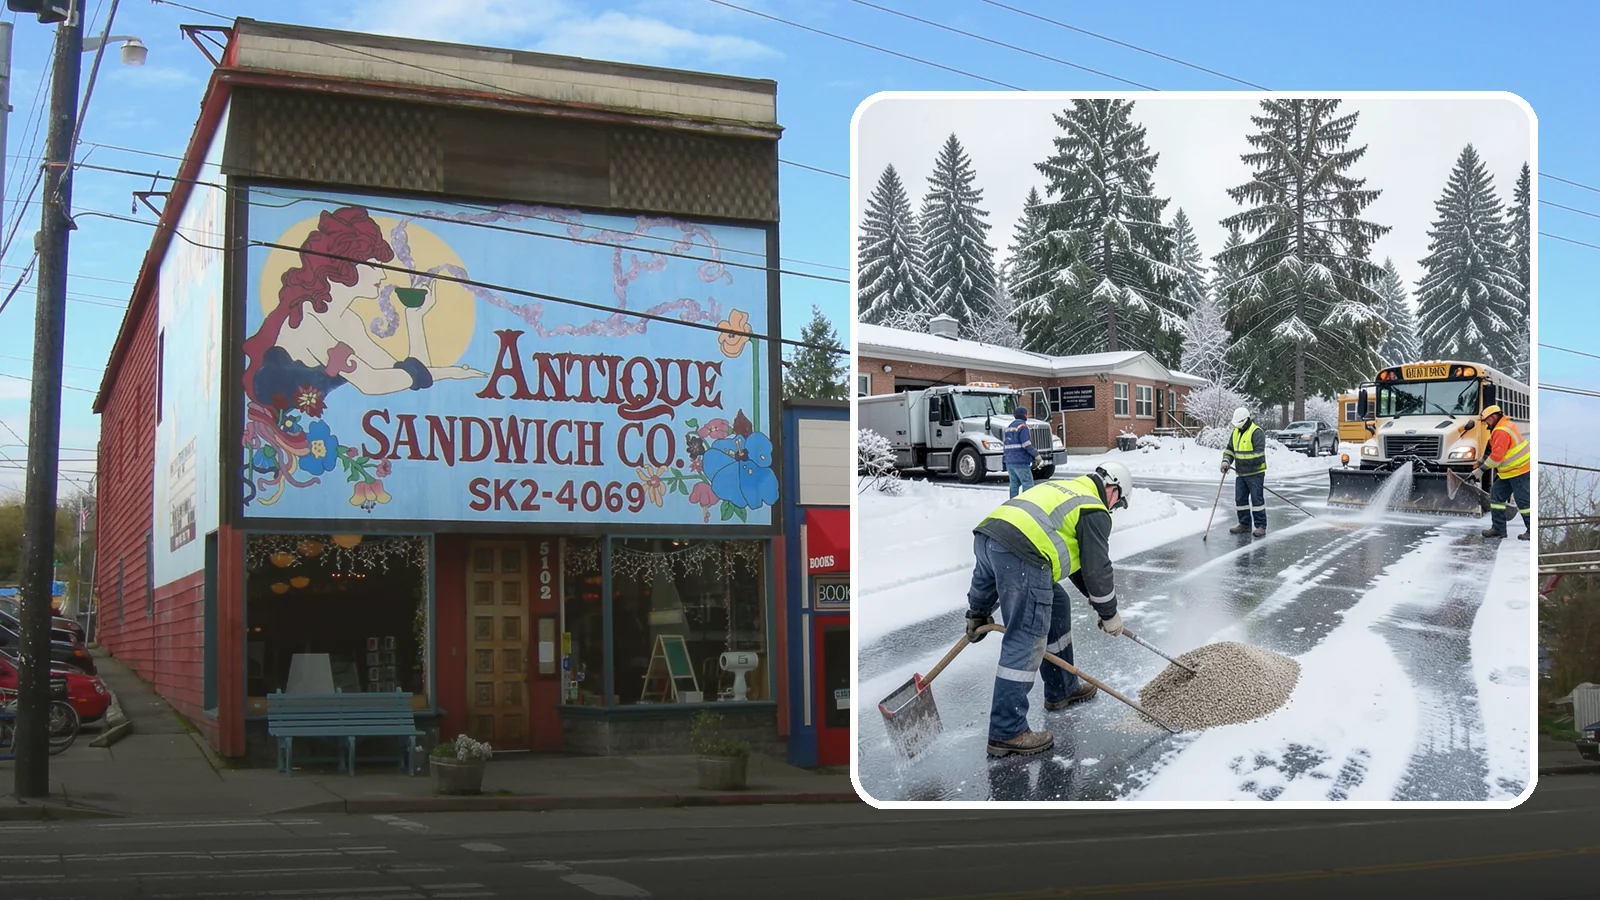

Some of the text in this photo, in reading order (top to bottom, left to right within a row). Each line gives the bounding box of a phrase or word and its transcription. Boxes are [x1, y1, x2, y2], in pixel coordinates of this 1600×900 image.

[476, 328, 724, 421] ANTIQUE
[361, 408, 685, 469] SANDWICH CO.
[468, 477, 646, 513] SK2-4069
[540, 541, 551, 600] 5102
[809, 554, 835, 569] BOOKS
